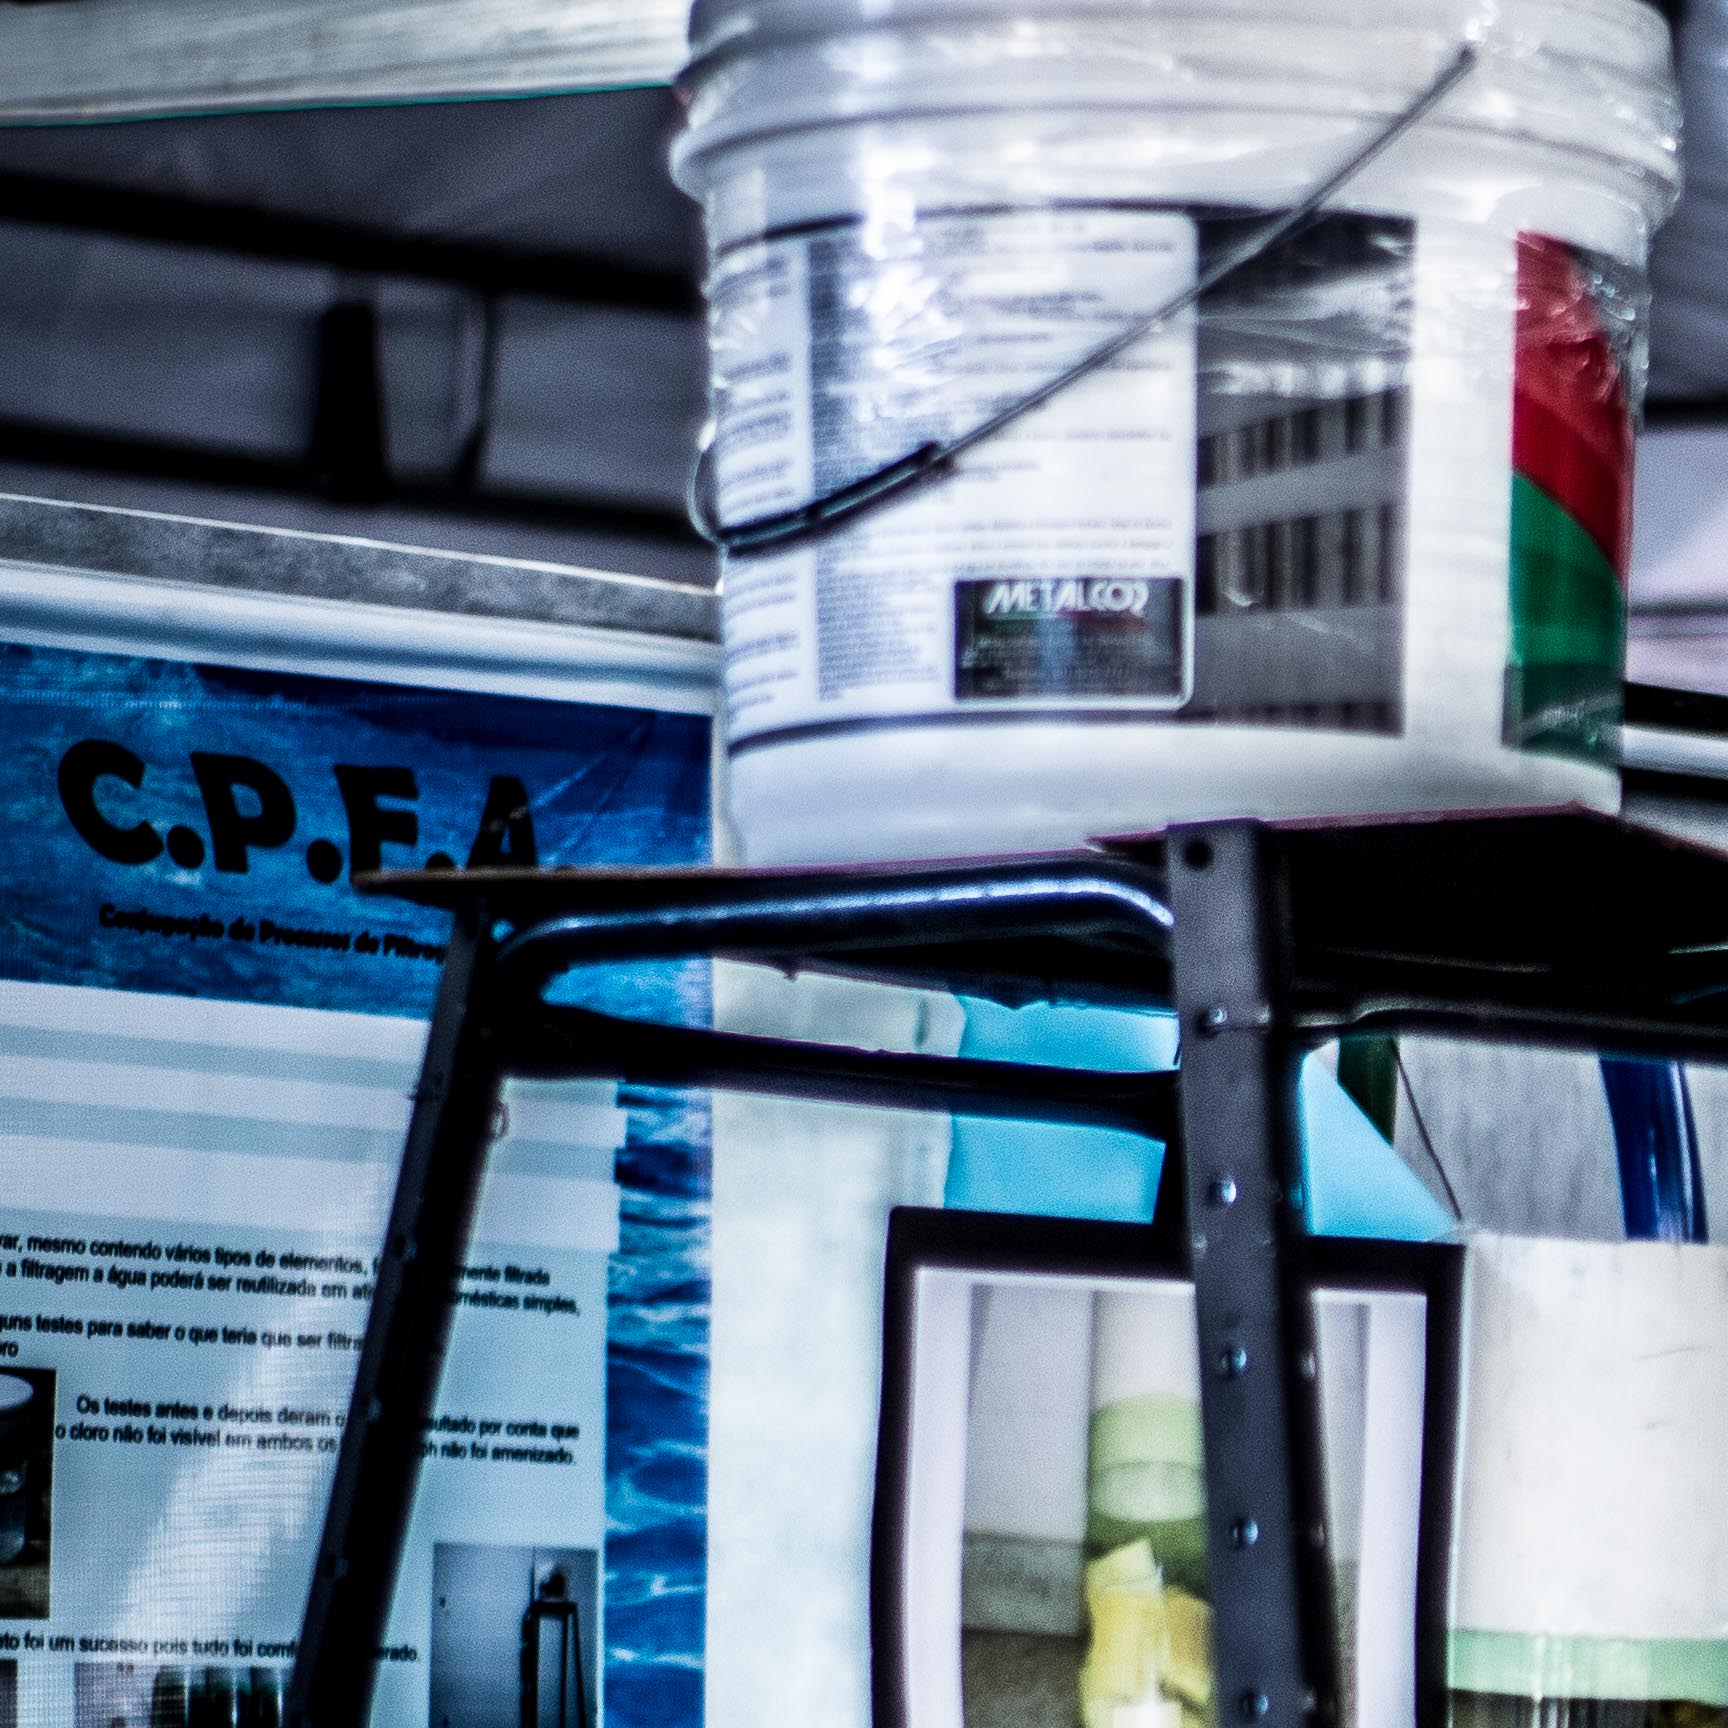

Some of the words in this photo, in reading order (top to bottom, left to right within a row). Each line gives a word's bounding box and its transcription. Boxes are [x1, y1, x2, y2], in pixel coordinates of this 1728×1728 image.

[27, 1235, 86, 1255] mesmo
[90, 1240, 162, 1260] contendo
[215, 1246, 251, 1269] tipos
[255, 1250, 275, 1268] de
[21, 1258, 90, 1285] filtragem
[107, 1265, 147, 1289] água
[207, 1276, 232, 1292] ser
[321, 1283, 347, 1299] em
[36, 1313, 83, 1335] testes
[87, 1319, 123, 1340] para
[126, 1319, 172, 1340] saber
[174, 1325, 186, 1341] o
[188, 1326, 218, 1347] que
[222, 1325, 258, 1346] teria
[297, 1333, 323, 1348] ser
[77, 1393, 100, 1415] Os
[104, 1395, 151, 1418] testes
[155, 1399, 199, 1420] antes
[202, 1405, 214, 1421] e
[479, 1420, 503, 1439] por
[506, 1421, 548, 1438] conta
[550, 1423, 581, 1443] que
[55, 1424, 66, 1441] o
[70, 1421, 109, 1442] cloro
[113, 1423, 144, 1444] não
[147, 1423, 167, 1445] foi
[257, 1432, 314, 1451] ambos
[440, 1440, 467, 1458] não
[470, 1441, 488, 1459] foi
[24, 1629, 45, 1651] foi
[49, 1635, 75, 1652] um
[79, 1635, 149, 1654] sucesso
[234, 1638, 253, 1657] foi
